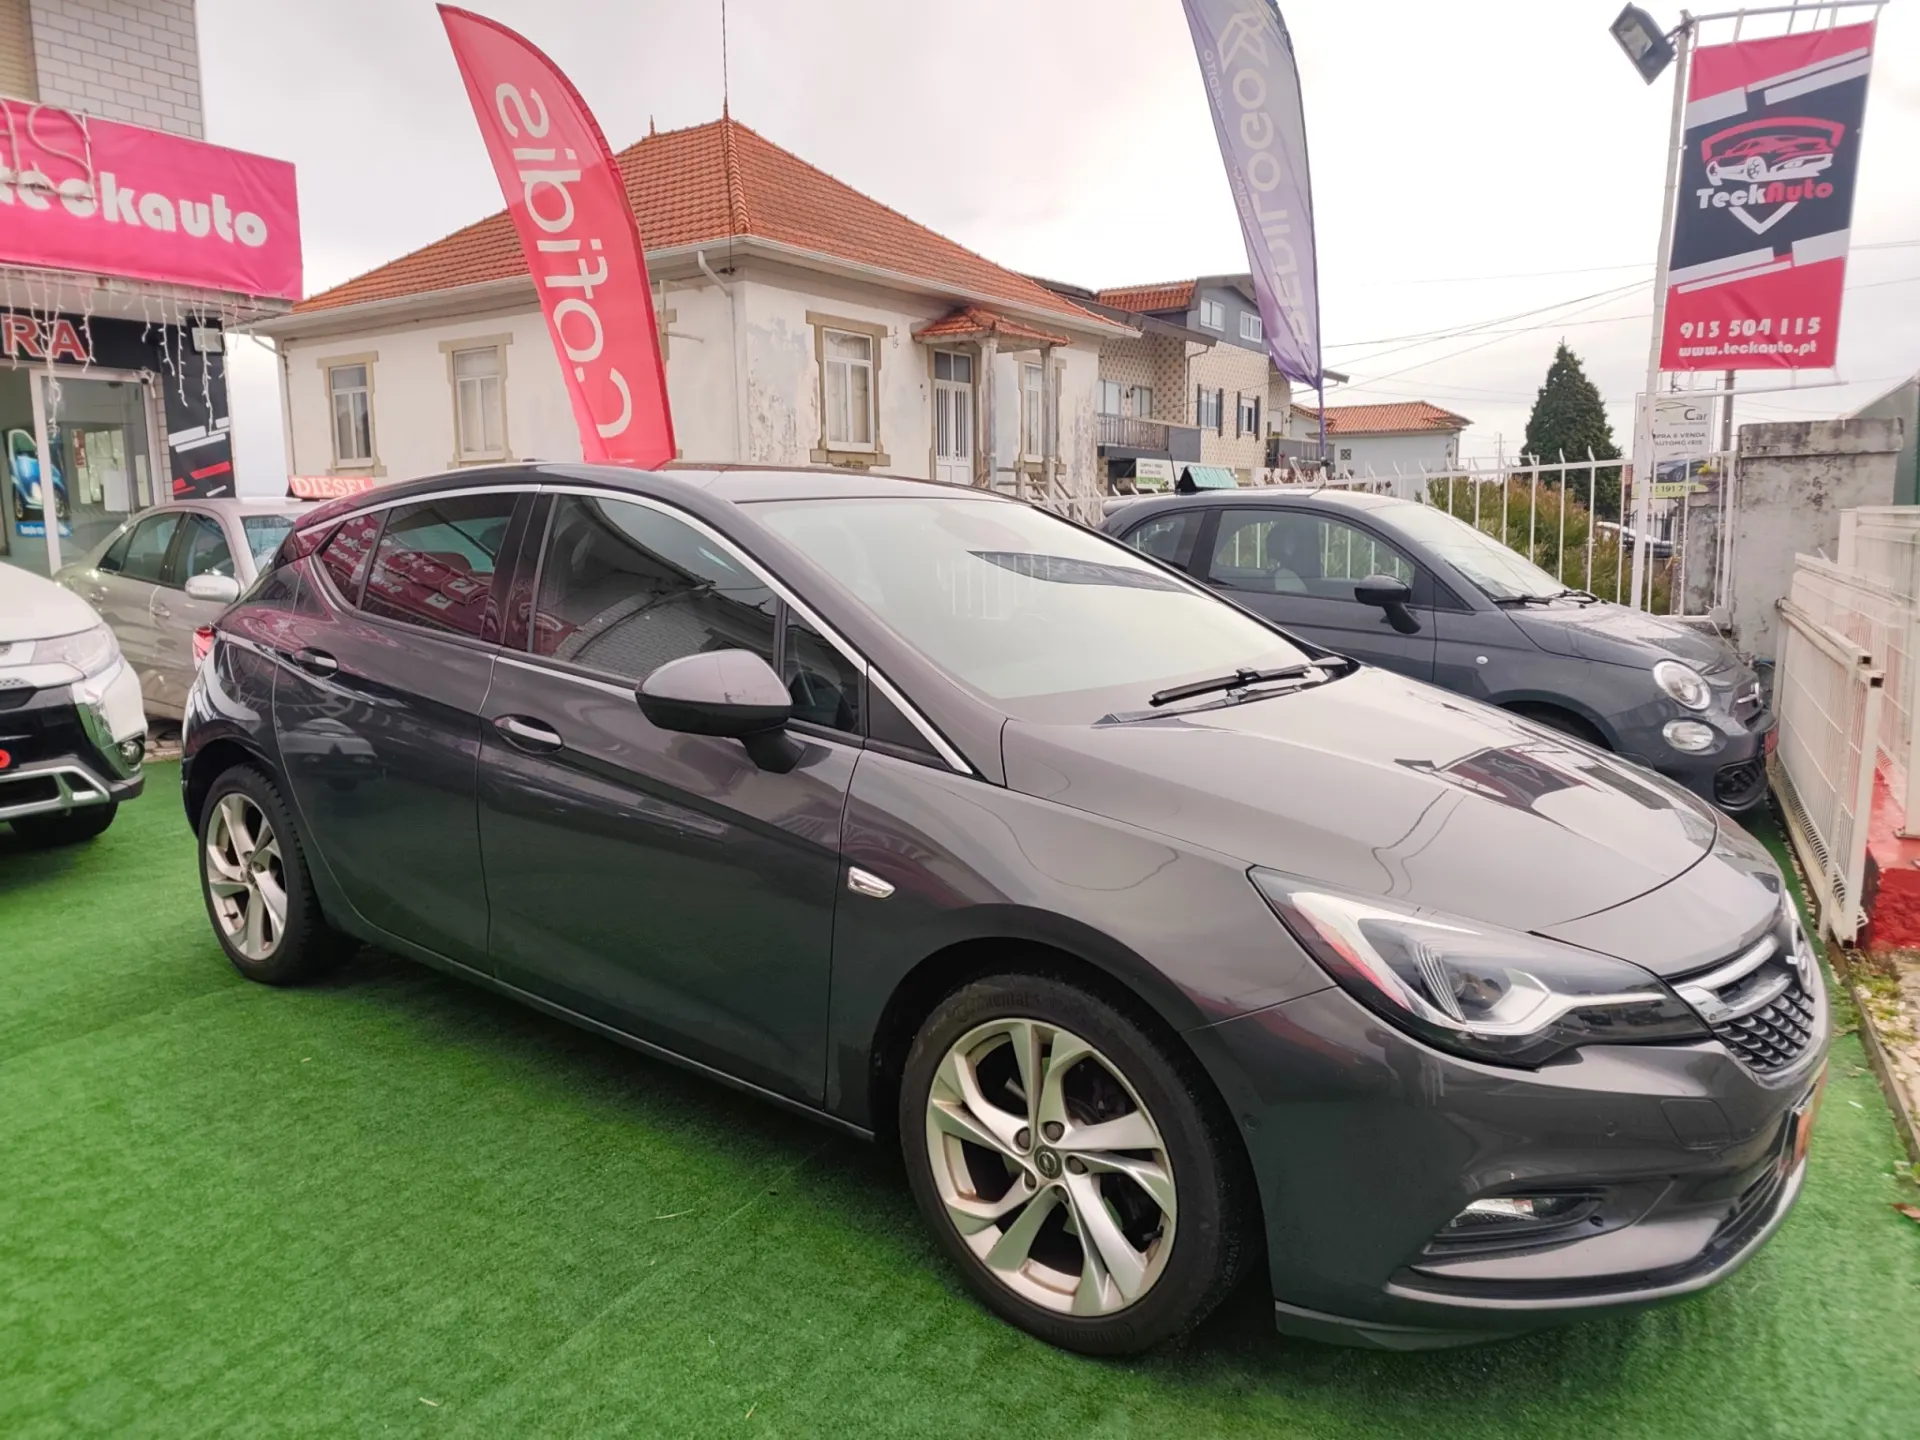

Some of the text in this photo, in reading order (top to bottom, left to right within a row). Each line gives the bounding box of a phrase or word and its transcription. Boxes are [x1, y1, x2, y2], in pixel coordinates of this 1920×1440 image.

[1696, 178, 1833, 209] TeckAuto
[1728, 318, 1771, 337] 504
[1780, 316, 1821, 335] 115
[1678, 340, 1817, 356] www.teckauto.pt
[1684, 408, 1708, 421] Car
